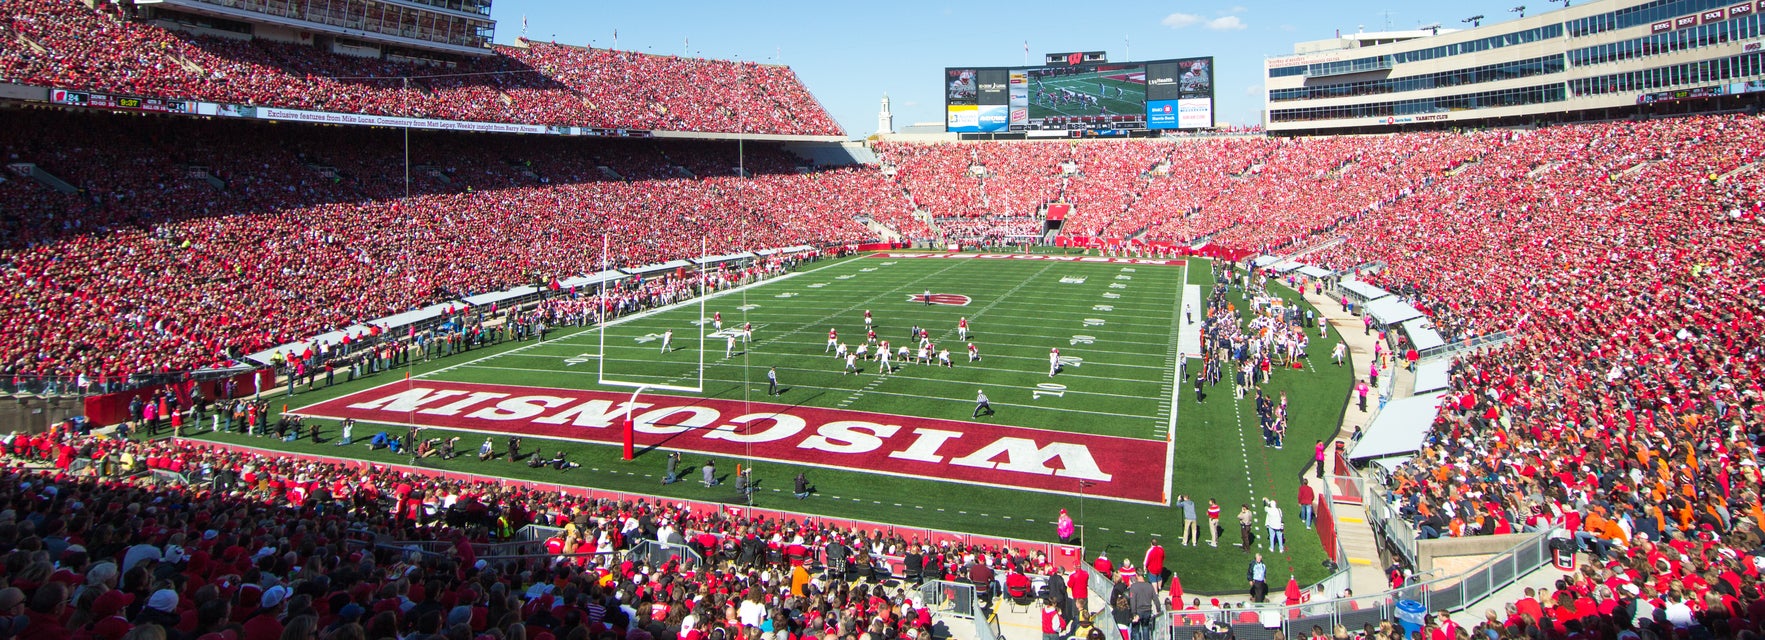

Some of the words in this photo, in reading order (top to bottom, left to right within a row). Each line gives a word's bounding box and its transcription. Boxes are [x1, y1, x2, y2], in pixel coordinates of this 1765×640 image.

[1731, 5, 1750, 14] 1906
[120, 98, 138, 107] 9:37
[267, 110, 298, 119] Exclusive
[299, 111, 326, 121] features
[326, 113, 341, 121] from
[341, 115, 357, 123] Mike
[376, 117, 413, 127] Commentary
[413, 119, 427, 127] from
[456, 122, 476, 130] Weekly
[476, 122, 494, 131] insight
[505, 125, 519, 133] Barry
[1032, 382, 1068, 400] 10
[347, 387, 1113, 482] WISCONSIN
